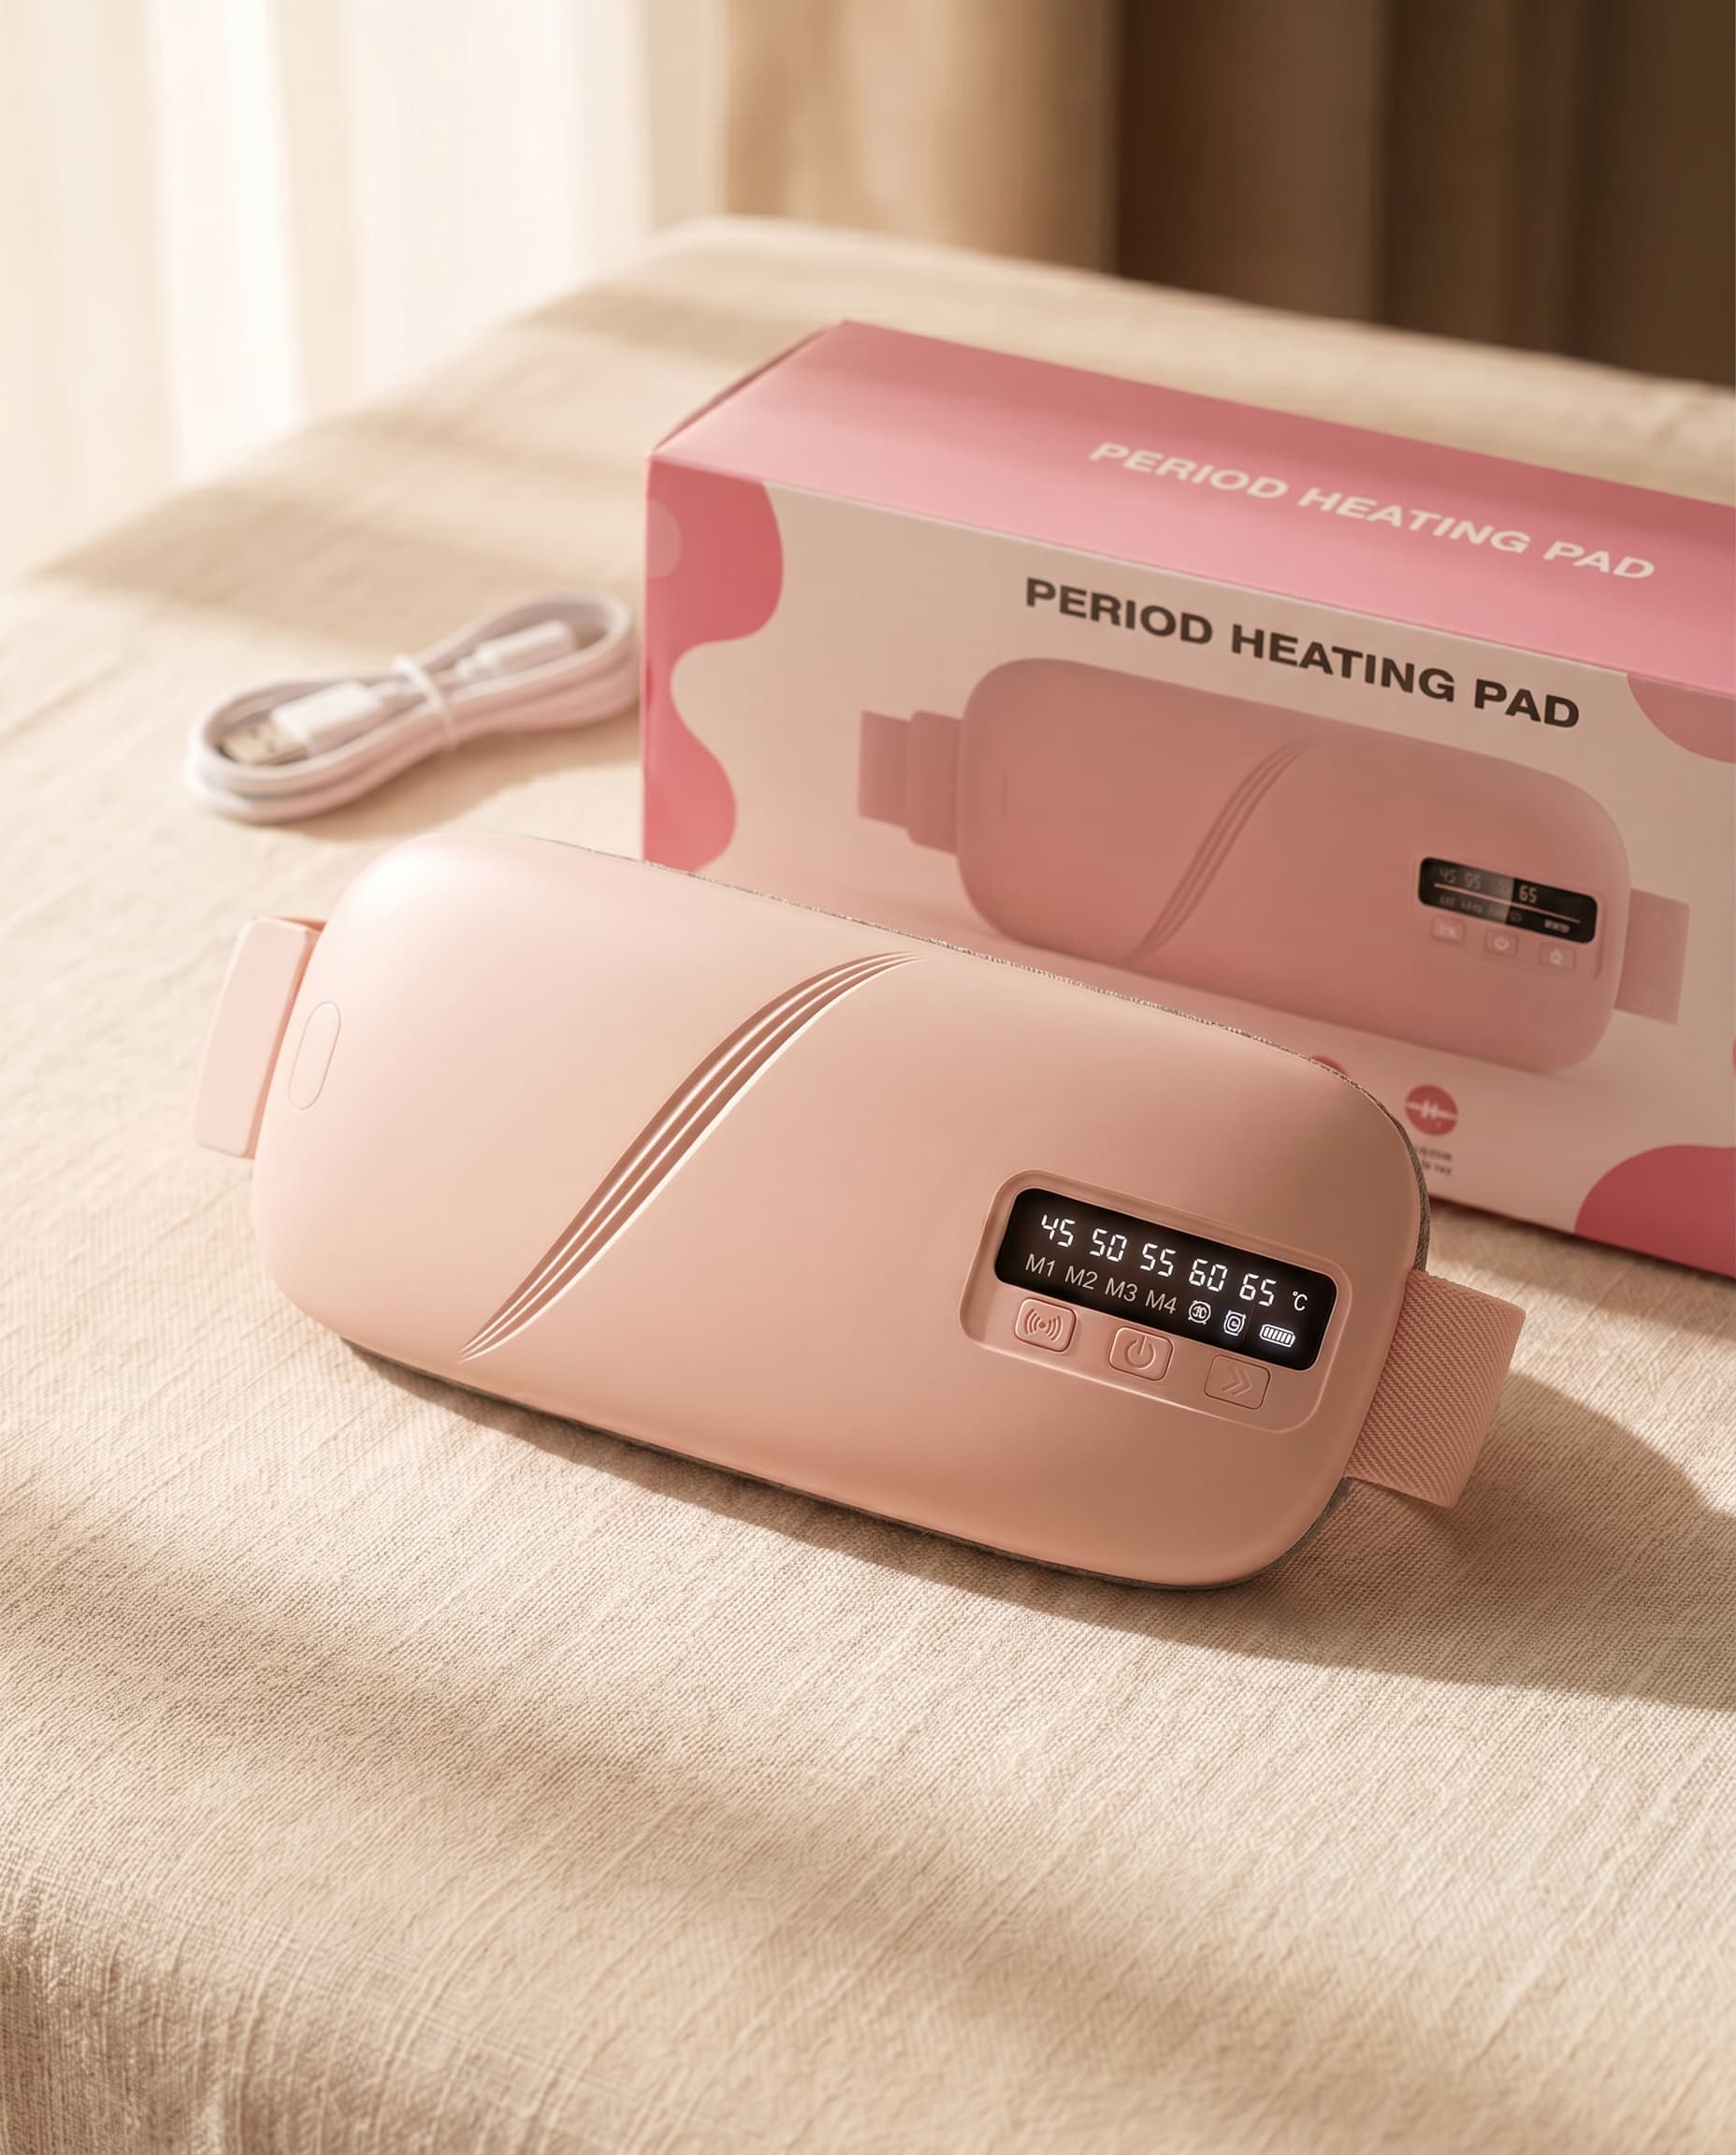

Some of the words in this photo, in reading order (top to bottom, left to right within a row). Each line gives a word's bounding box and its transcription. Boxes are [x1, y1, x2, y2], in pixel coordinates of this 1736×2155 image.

[1089, 441, 1288, 499] PERIOD
[1297, 487, 1531, 555] HEATING
[1542, 540, 1656, 580] PAD
[1025, 577, 1213, 645] PERIOD
[1231, 623, 1455, 702] HEATING
[1473, 678, 1580, 729] PAD
[1518, 885, 1538, 904] 65
[1025, 1253, 1056, 1278] M1
[1064, 1266, 1099, 1290] M2
[1105, 1277, 1138, 1303] M3
[1145, 1290, 1178, 1314] M4
[1040, 1214, 1076, 1249] 45
[1089, 1227, 1127, 1263] 50
[1139, 1242, 1177, 1278] 55
[1188, 1259, 1228, 1293] 60
[1238, 1273, 1278, 1308] 65
